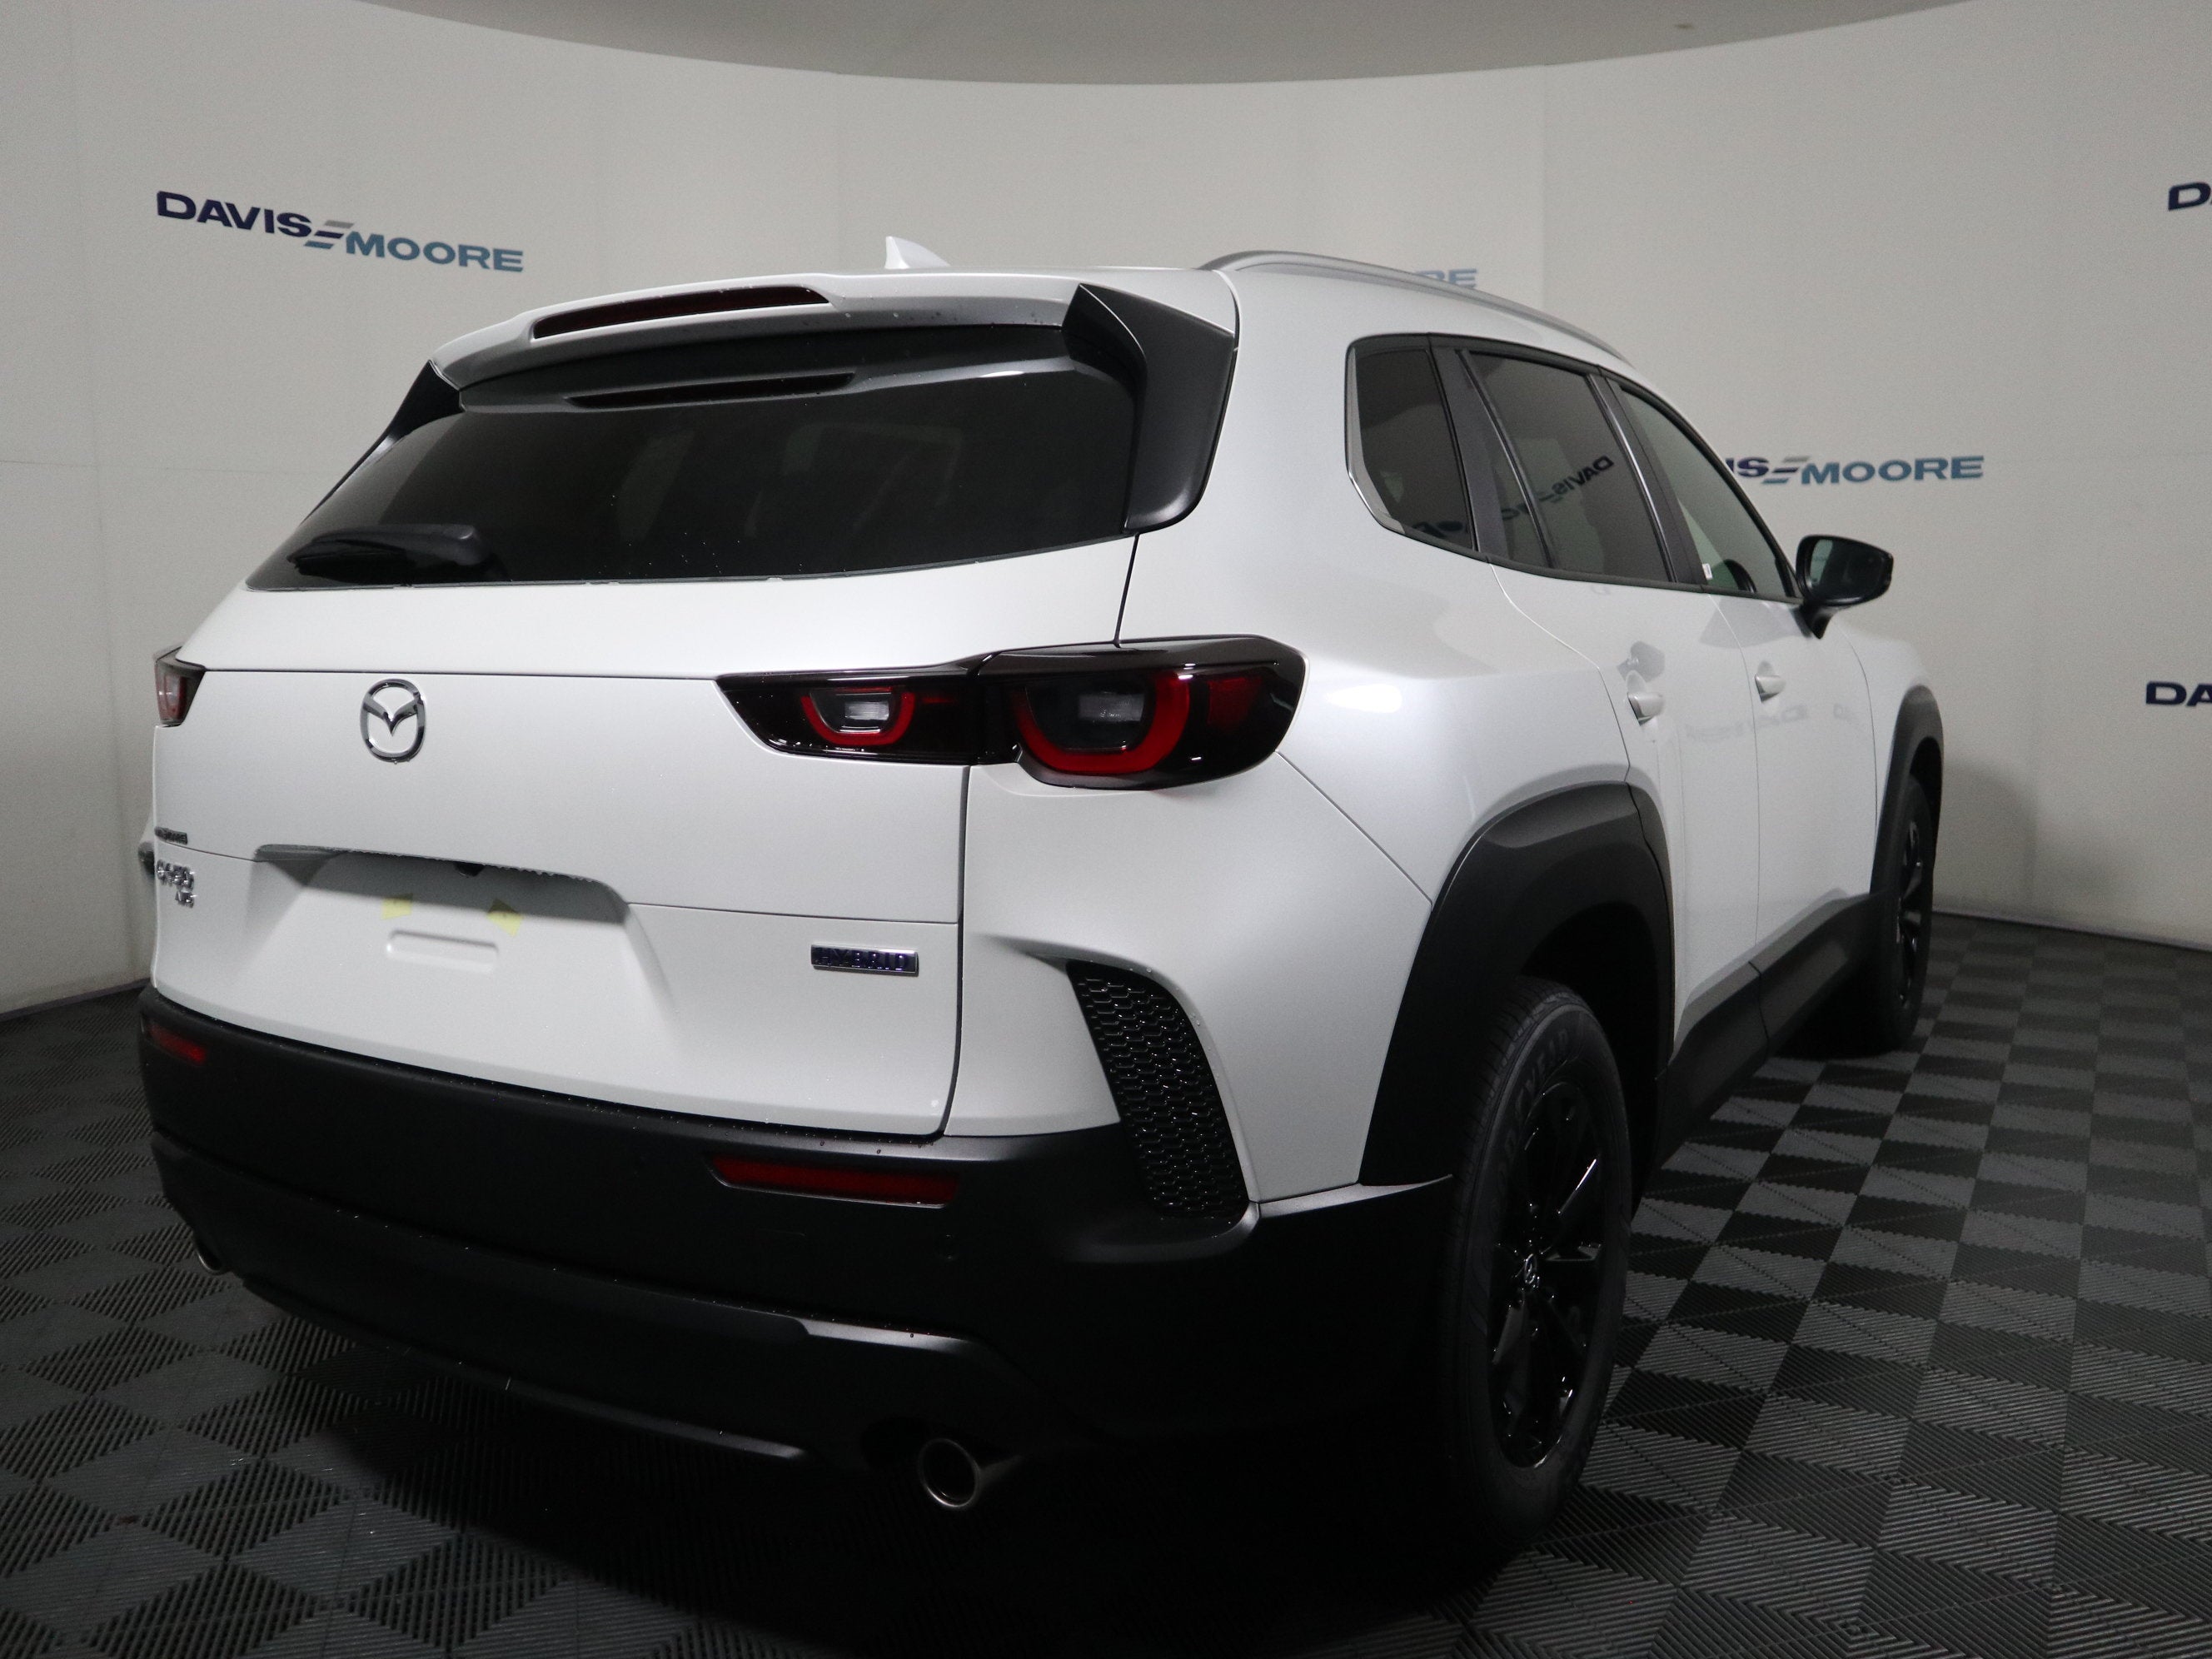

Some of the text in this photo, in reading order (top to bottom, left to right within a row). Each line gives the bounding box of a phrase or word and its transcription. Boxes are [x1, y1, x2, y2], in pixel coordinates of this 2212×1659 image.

[157, 191, 524, 272] DAVIS MOORE
[1801, 456, 1985, 485] MOORE
